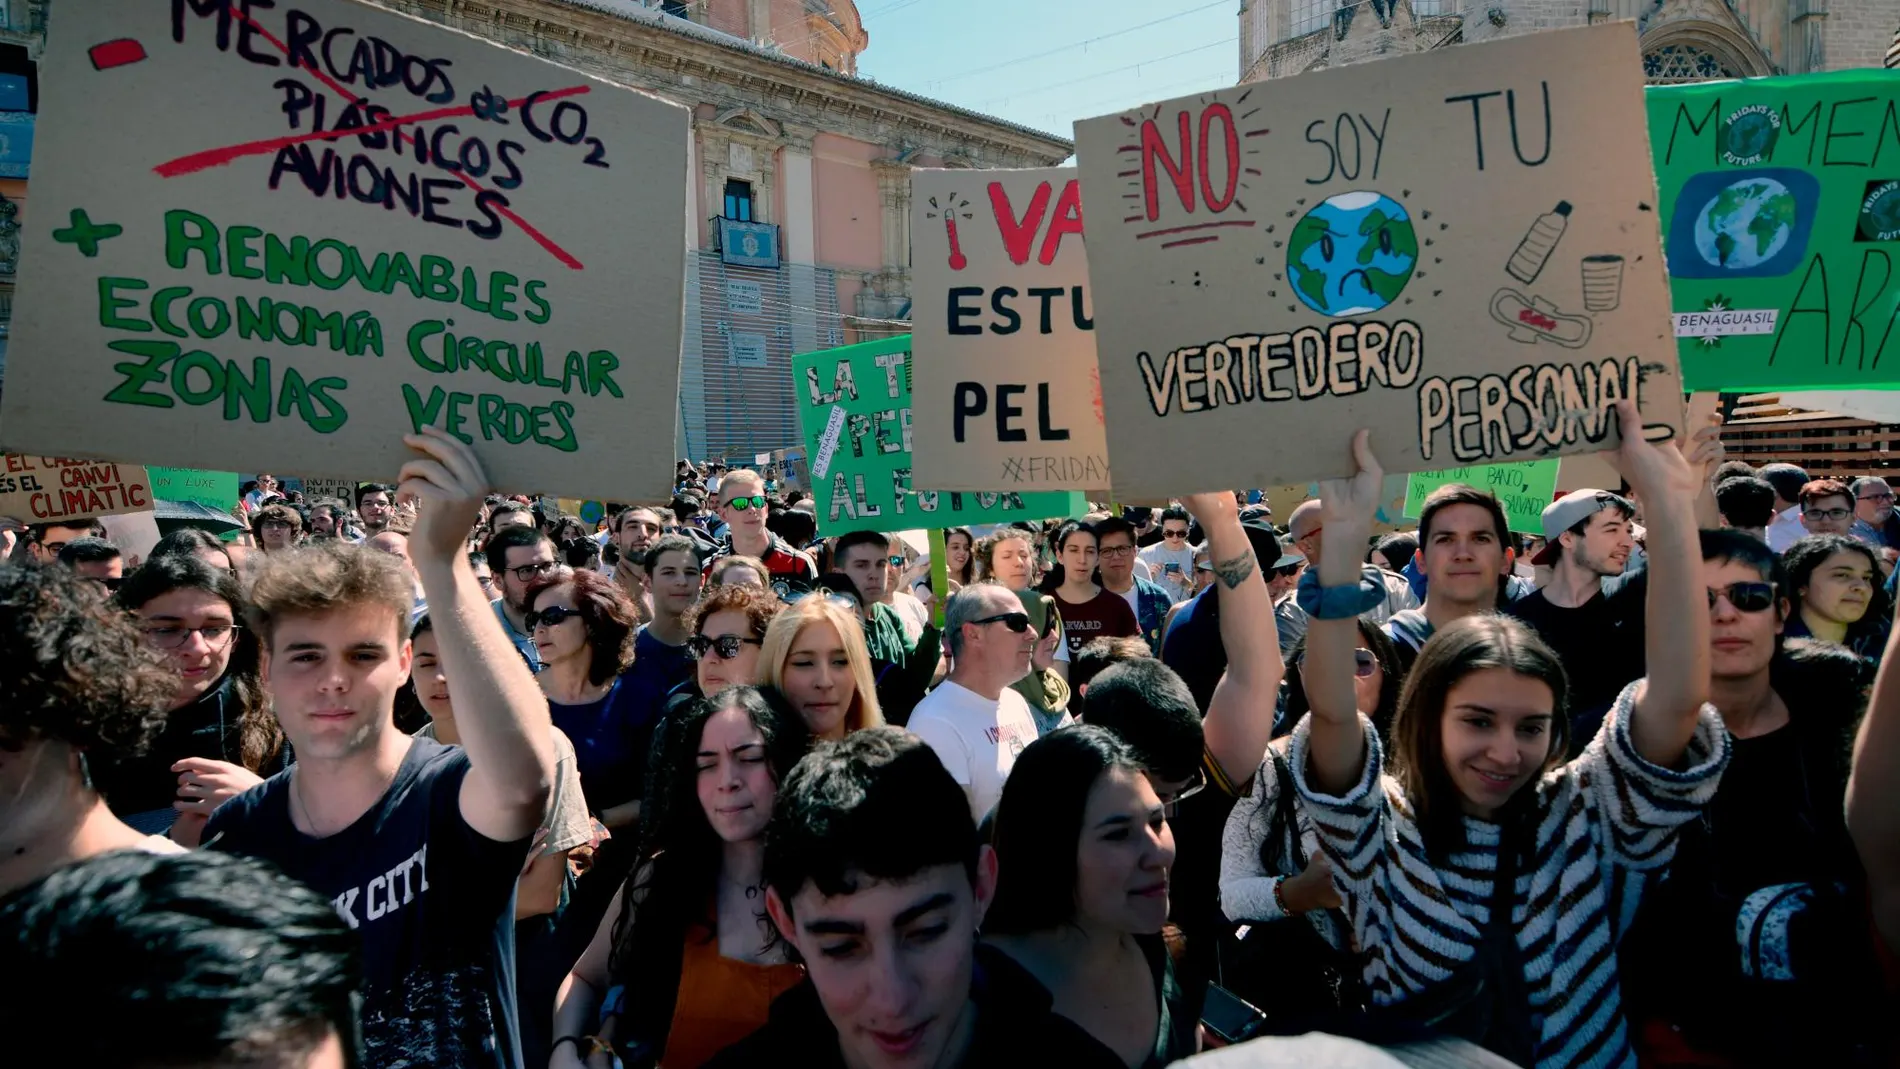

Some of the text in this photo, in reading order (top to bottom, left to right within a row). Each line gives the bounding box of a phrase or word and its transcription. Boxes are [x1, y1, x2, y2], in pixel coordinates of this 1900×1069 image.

[170, 0, 455, 103] MERCADOS
[1726, 105, 1781, 129] FRIDAYS FOR
[1141, 81, 1552, 222] NO SOY TU
[1723, 151, 1761, 167] FUTURE
[268, 142, 510, 240] AVIONES
[1862, 181, 1898, 214] FRIDAYS
[164, 209, 551, 324] RENOVABLES
[947, 285, 1095, 335] ESTU
[1679, 312, 1774, 326] BENAGUASIL
[805, 359, 859, 407] LA
[1138, 319, 1423, 417] VERTEDERO
[103, 339, 579, 452] ZONAS VERDES
[953, 381, 1071, 443] PEL
[1418, 356, 1675, 461] PERSONAL
[818, 408, 841, 462] BENAGUASIL
[5, 453, 36, 473] EL
[20, 475, 43, 492] EL
[60, 462, 121, 488] CANVI
[828, 472, 881, 523] AL
[366, 842, 430, 921] CITY
